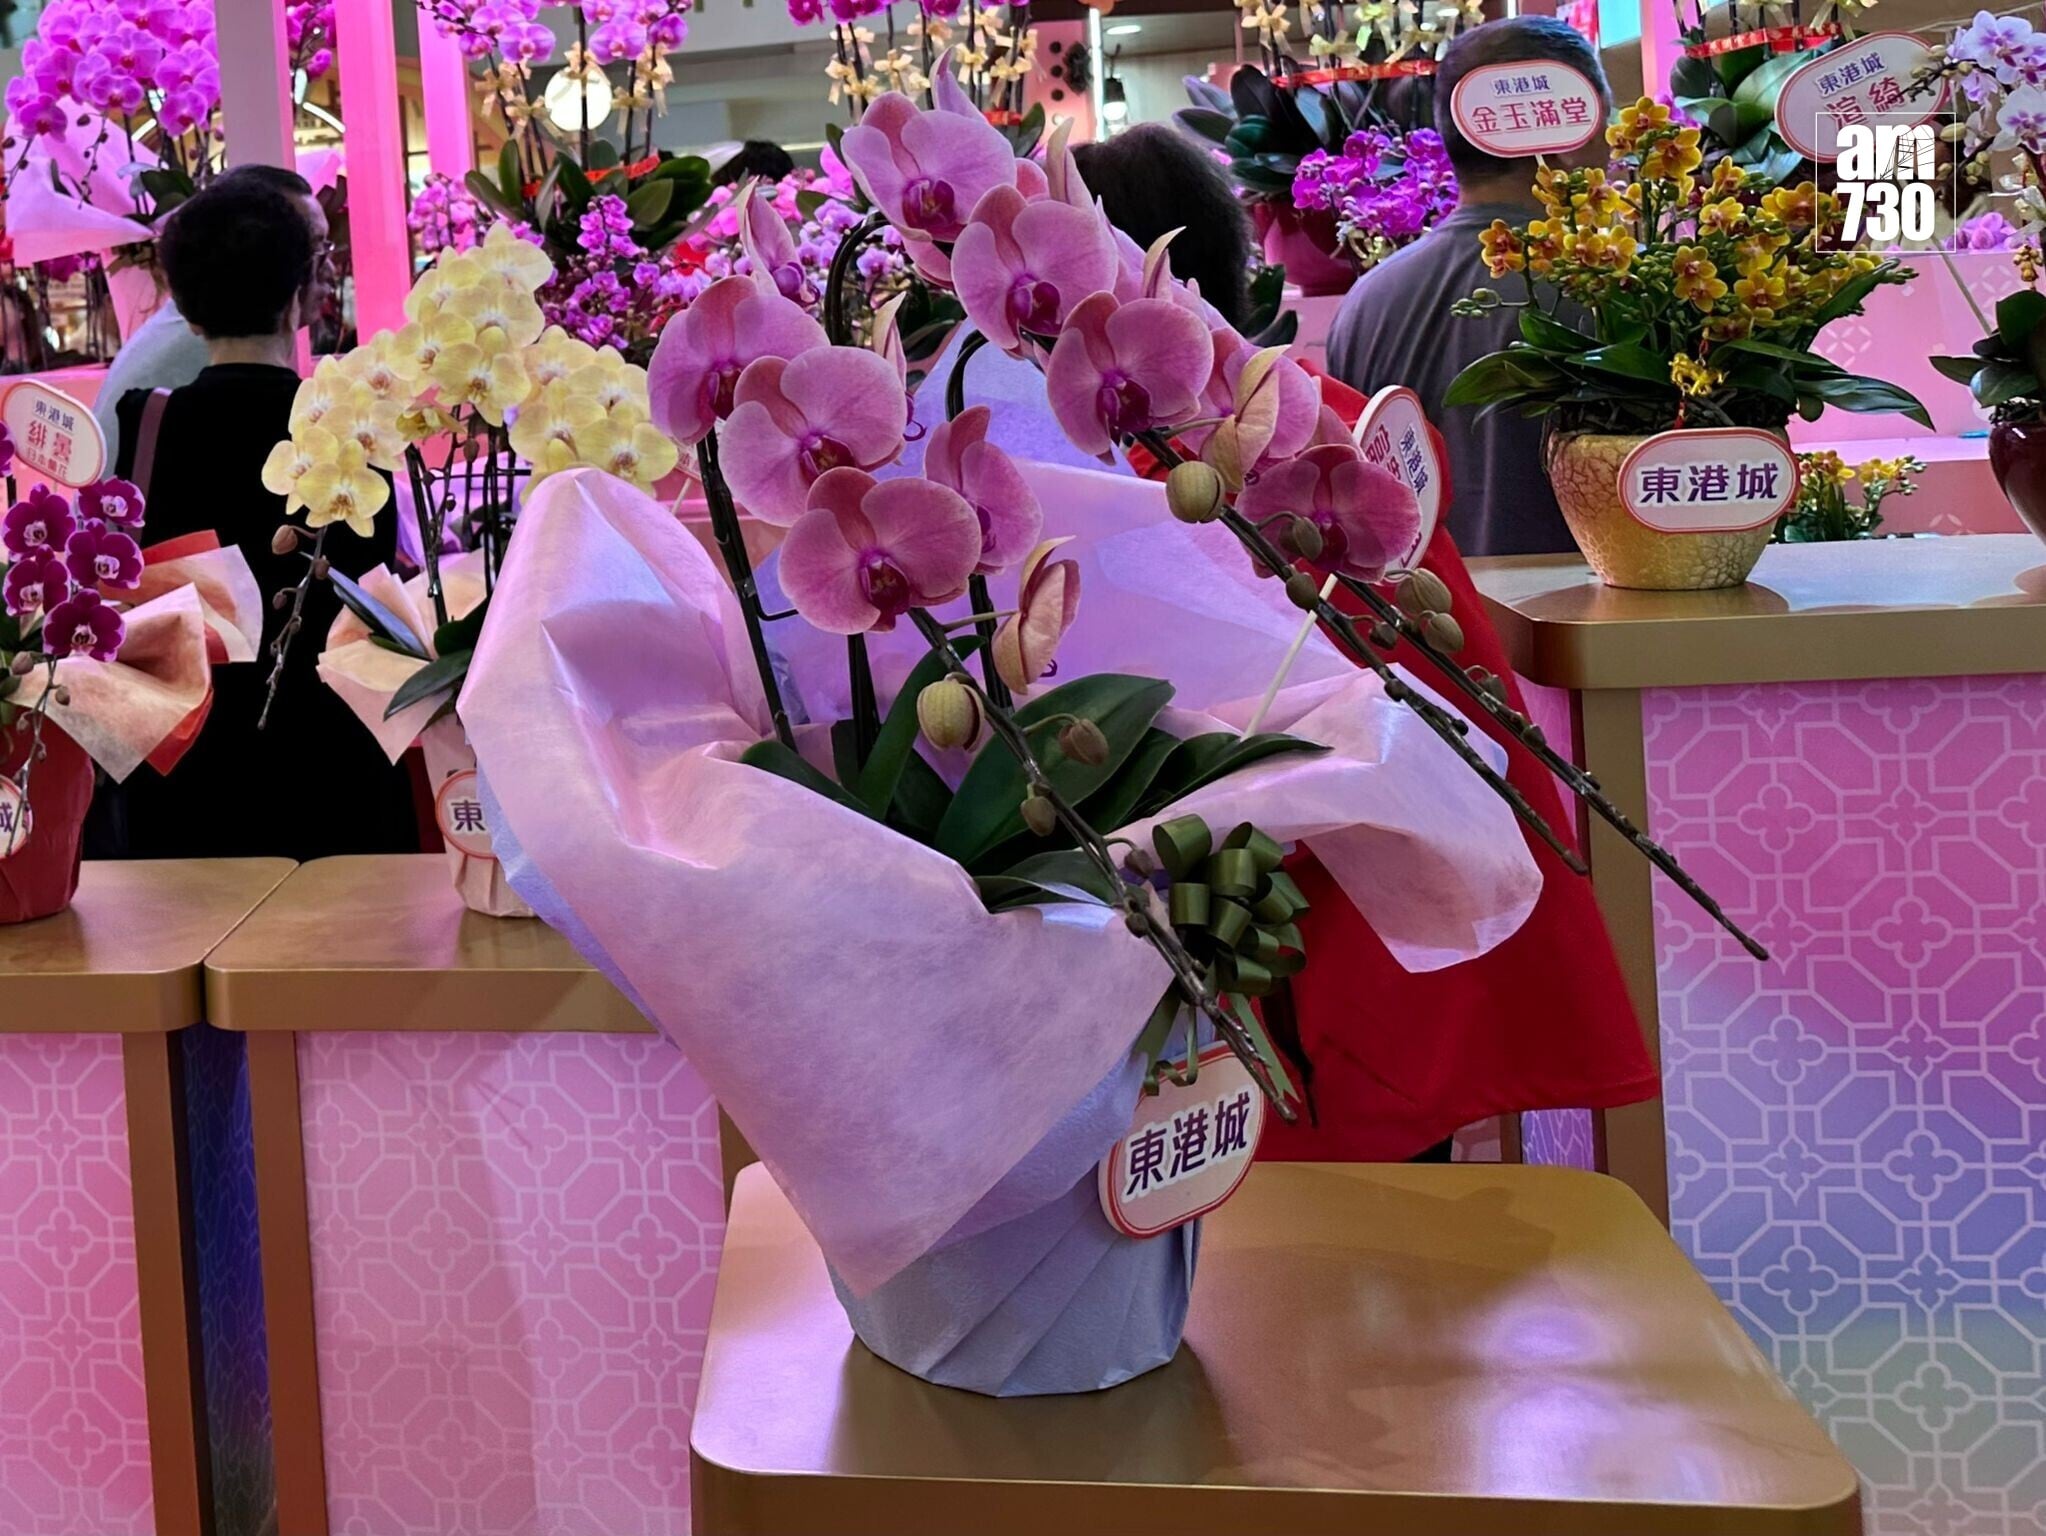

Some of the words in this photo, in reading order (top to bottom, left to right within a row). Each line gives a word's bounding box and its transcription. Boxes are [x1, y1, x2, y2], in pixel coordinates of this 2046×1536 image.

[1495, 75, 1551, 95] 東港城
[1818, 52, 1885, 94] 東港城
[1472, 97, 1592, 134] 金玉滿堂
[35, 400, 74, 431] 東港城
[1400, 427, 1429, 497] 東港城
[1640, 463, 1779, 503] 東港城
[1126, 1092, 1250, 1196] 東港城
